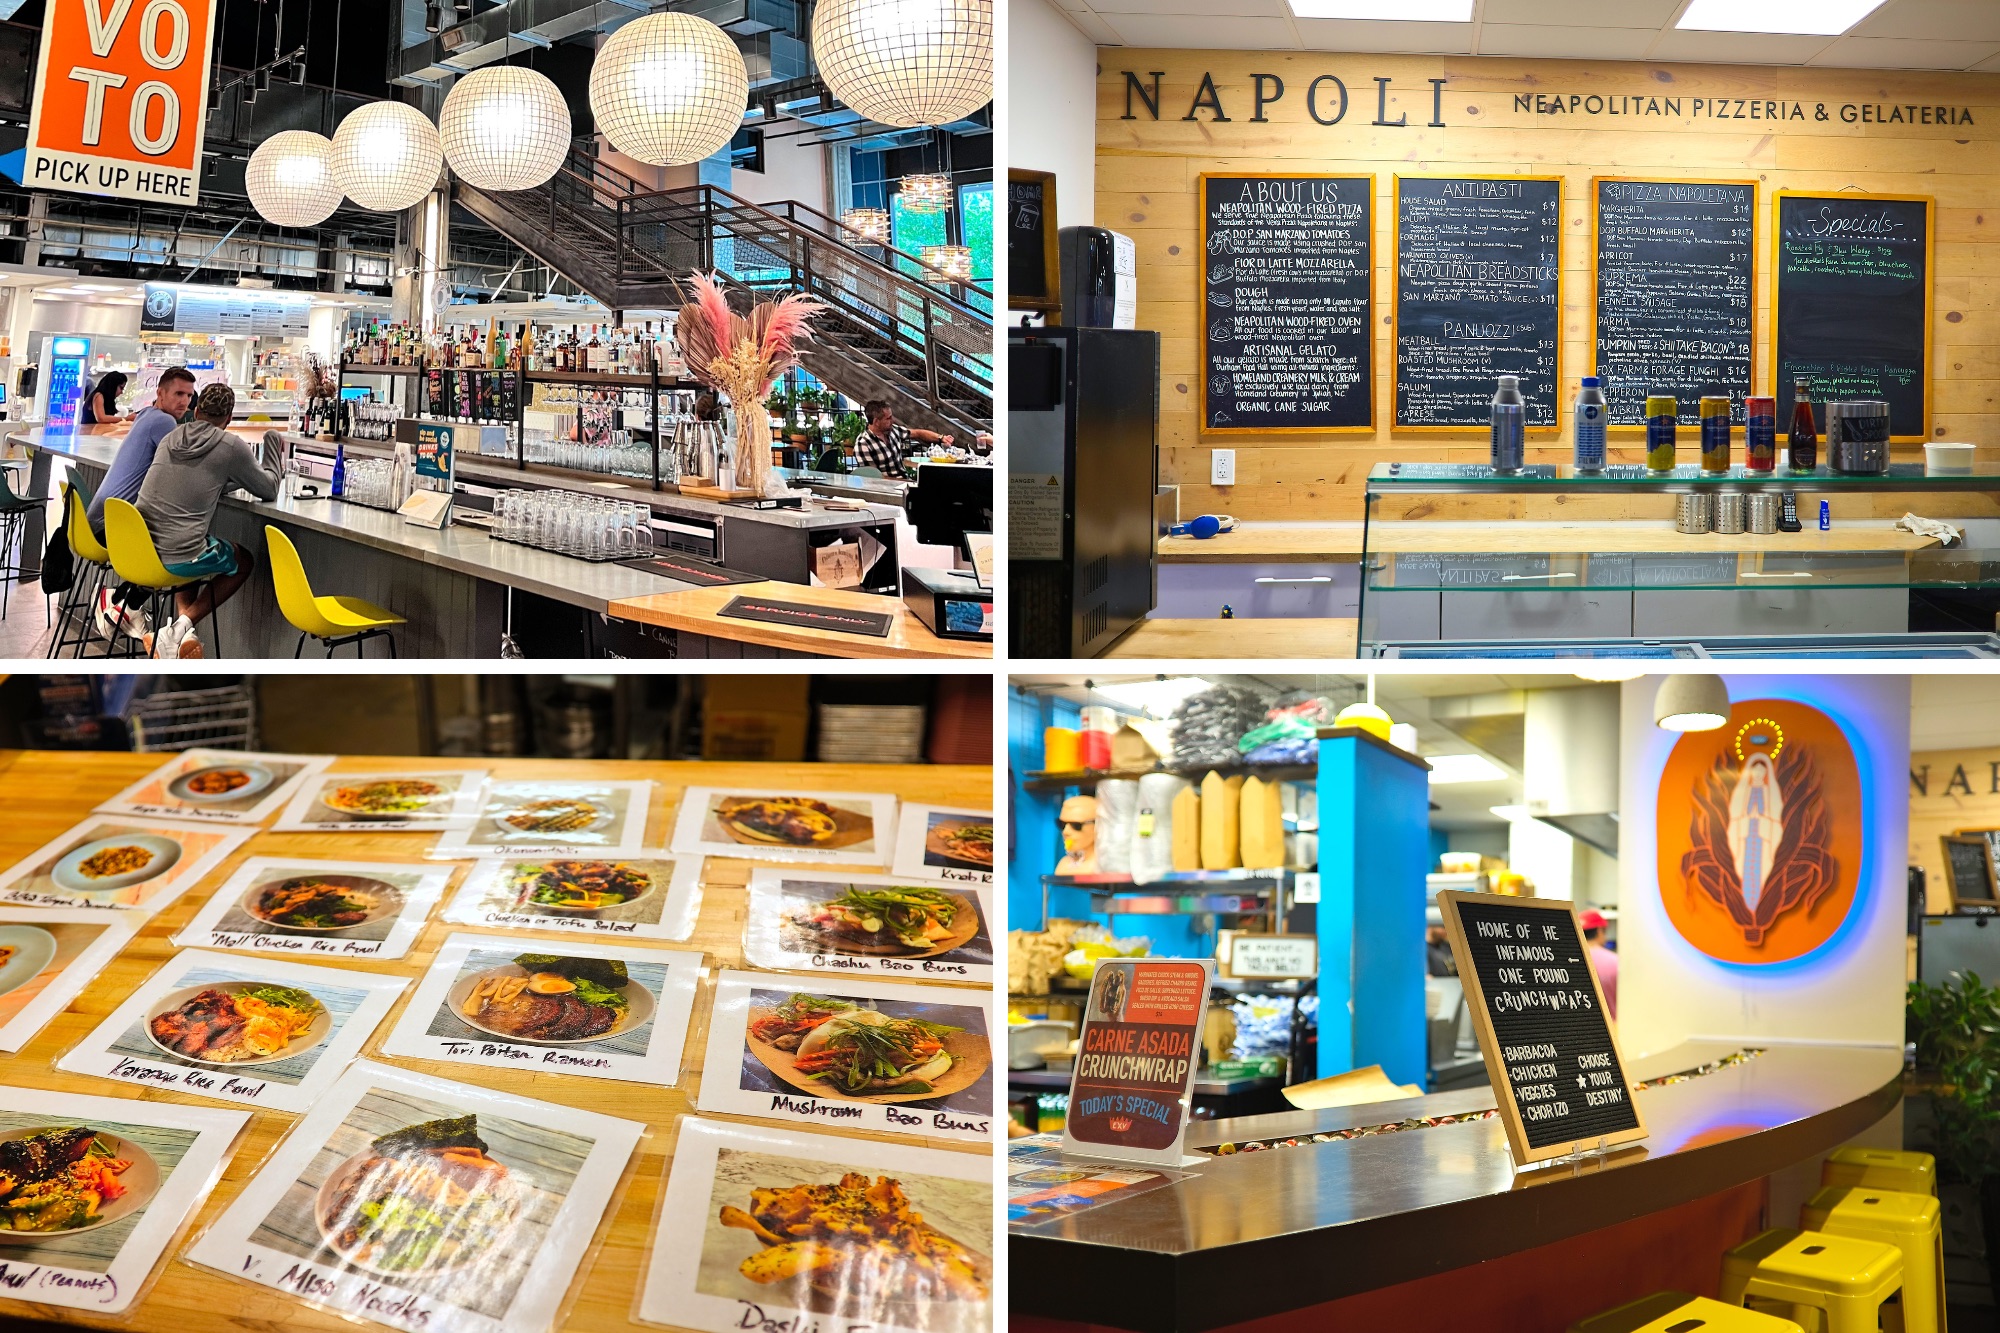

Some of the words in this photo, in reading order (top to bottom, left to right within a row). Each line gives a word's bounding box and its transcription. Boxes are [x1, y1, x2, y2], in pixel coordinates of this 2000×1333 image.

[82, 0, 191, 71] VO
[1120, 71, 1446, 127] NAPOLI
[68, 66, 181, 156] TO
[1513, 94, 1682, 117] NEAPOLITAN
[1693, 98, 1804, 121] PIZZERIA
[1814, 103, 1830, 121] &
[1839, 103, 1975, 126] GELATERIA
[35, 157, 90, 185] PICK
[99, 166, 129, 188] UP
[136, 171, 192, 197] HERE
[1240, 181, 1307, 202] ABOUT
[1312, 182, 1338, 204] US
[1442, 182, 1523, 198] ANTIPASTI
[1622, 185, 1661, 201] PIZZA
[1668, 185, 1745, 203] NAPOLETANA
[1400, 197, 1422, 205] HOUSE
[1424, 197, 1447, 206] SALAD
[1219, 203, 1272, 213] NEAPOLITAN
[1338, 203, 1363, 215] PIZZA
[1599, 204, 1645, 214] MARGHERITA
[1541, 218, 1557, 226] $12
[1255, 229, 1273, 240] SAN
[1274, 229, 1310, 240] MARZANO
[1311, 229, 1351, 240] TOMATOES
[1599, 226, 1616, 236] DOP
[1618, 226, 1648, 236] BUFFALO
[1649, 227, 1695, 237] MARGHERITA
[1540, 235, 1556, 243] $12
[1399, 252, 1437, 260] MARINATED
[1598, 252, 1634, 260] APRICOT
[1729, 253, 1748, 262] $17
[1234, 258, 1255, 269] FIOR
[1257, 258, 1266, 269] DI
[1268, 258, 1294, 269] LATTE
[1295, 258, 1356, 269] MOZZARELLA
[1400, 263, 1472, 279] NEAPOLITAN
[1479, 265, 1559, 281] BREADSTICKS
[1598, 272, 1648, 282] SUPREMA
[1728, 275, 1747, 285] $22
[1234, 287, 1269, 298] DOUGH
[1402, 292, 1420, 302] SAN
[1423, 293, 1461, 302] MARZANO
[1468, 293, 1499, 303] TOMATO
[1598, 297, 1631, 306] FENNEL
[1730, 298, 1747, 308] $18
[1234, 316, 1286, 327] NEAPOLITAN
[1338, 316, 1362, 327] OVEN
[1598, 316, 1630, 326] PARMA
[1729, 317, 1747, 327] $18
[1398, 336, 1440, 346] MEATBALL
[1538, 339, 1554, 349] $13
[1597, 339, 1637, 351] PUMPKIN
[1659, 339, 1701, 352] SHIITAKE
[1243, 344, 1297, 356] ARTISANAL
[1299, 344, 1337, 356] GELATO
[1398, 355, 1434, 365] ROASTED
[1436, 356, 1479, 365] MUSHROOM
[1537, 356, 1554, 367] $12
[1597, 365, 1614, 375] FOX
[1617, 365, 1643, 374] FARM
[1651, 364, 1686, 375] FORAGE
[1689, 366, 1719, 376] FUNGHI
[1727, 366, 1747, 376] $16
[1232, 372, 1272, 383] HOMELAND
[1272, 373, 1309, 383] CREAMERY
[1309, 373, 1326, 383] MILK
[1328, 373, 1336, 383] &
[1336, 373, 1361, 383] CREAM
[1397, 382, 1431, 392] SALUMI
[1538, 384, 1554, 393] $12
[1236, 402, 1271, 412] ORGANIC
[1274, 402, 1297, 412] CANE
[1301, 402, 1332, 412] SUGAR
[1397, 409, 1435, 418] CAPRESE
[1537, 409, 1554, 418] $12
[486, 912, 531, 923] Chicken
[553, 917, 587, 929] Tofu
[593, 920, 637, 932] Salad
[1476, 921, 1510, 939] HOME
[1516, 923, 1531, 939] OF
[1542, 925, 1560, 941] HE
[1495, 944, 1555, 962] INFAMOUS
[811, 955, 871, 973] Chashu
[881, 957, 915, 974] Bao
[922, 960, 968, 976] Buns
[1498, 968, 1527, 985] ONE
[1533, 967, 1570, 985] POUND
[1494, 990, 1592, 1013] CRUNCHWRAPS
[440, 1041, 475, 1057] Tori
[1086, 1028, 1137, 1053] CARNE
[1138, 1030, 1189, 1057] ASADA
[1504, 1043, 1558, 1061] BARBACOA
[1578, 1052, 1612, 1070] CHOOSE
[1079, 1053, 1188, 1084] CRUNCHWRAP
[1511, 1063, 1558, 1082] CHICKEN
[1588, 1071, 1614, 1086] YOUR
[1517, 1083, 1557, 1102] VEGGIES
[1586, 1088, 1623, 1107] DESTINY
[1079, 1094, 1123, 1117] TODAY'S
[1126, 1096, 1171, 1126] SPECIAL
[1526, 1101, 1569, 1121] CHORIZO
[885, 1106, 924, 1127] Bao
[933, 1113, 990, 1134] Buns
